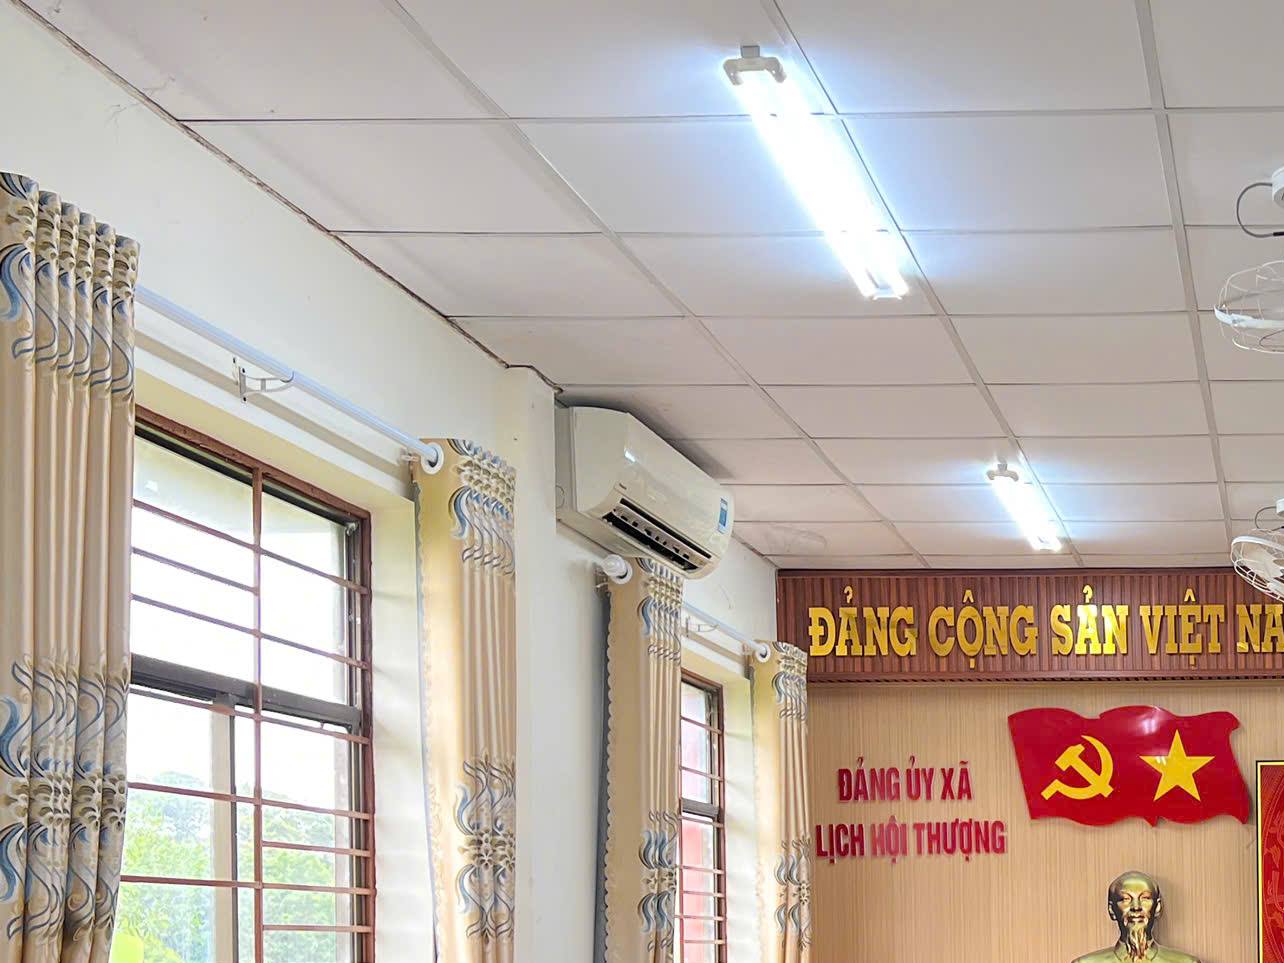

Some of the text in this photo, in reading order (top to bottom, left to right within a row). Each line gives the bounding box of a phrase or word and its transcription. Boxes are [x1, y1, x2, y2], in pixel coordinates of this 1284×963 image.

[808, 585, 918, 657] ĐẢNG
[928, 589, 1038, 669] CỘNG
[1051, 585, 1129, 655] SẢN
[1139, 588, 1225, 666] VIỆT
[838, 755, 973, 802] ĐẢNG ỦY XÃ
[815, 815, 1007, 864] LỊCH HỘI THƯỢNG
